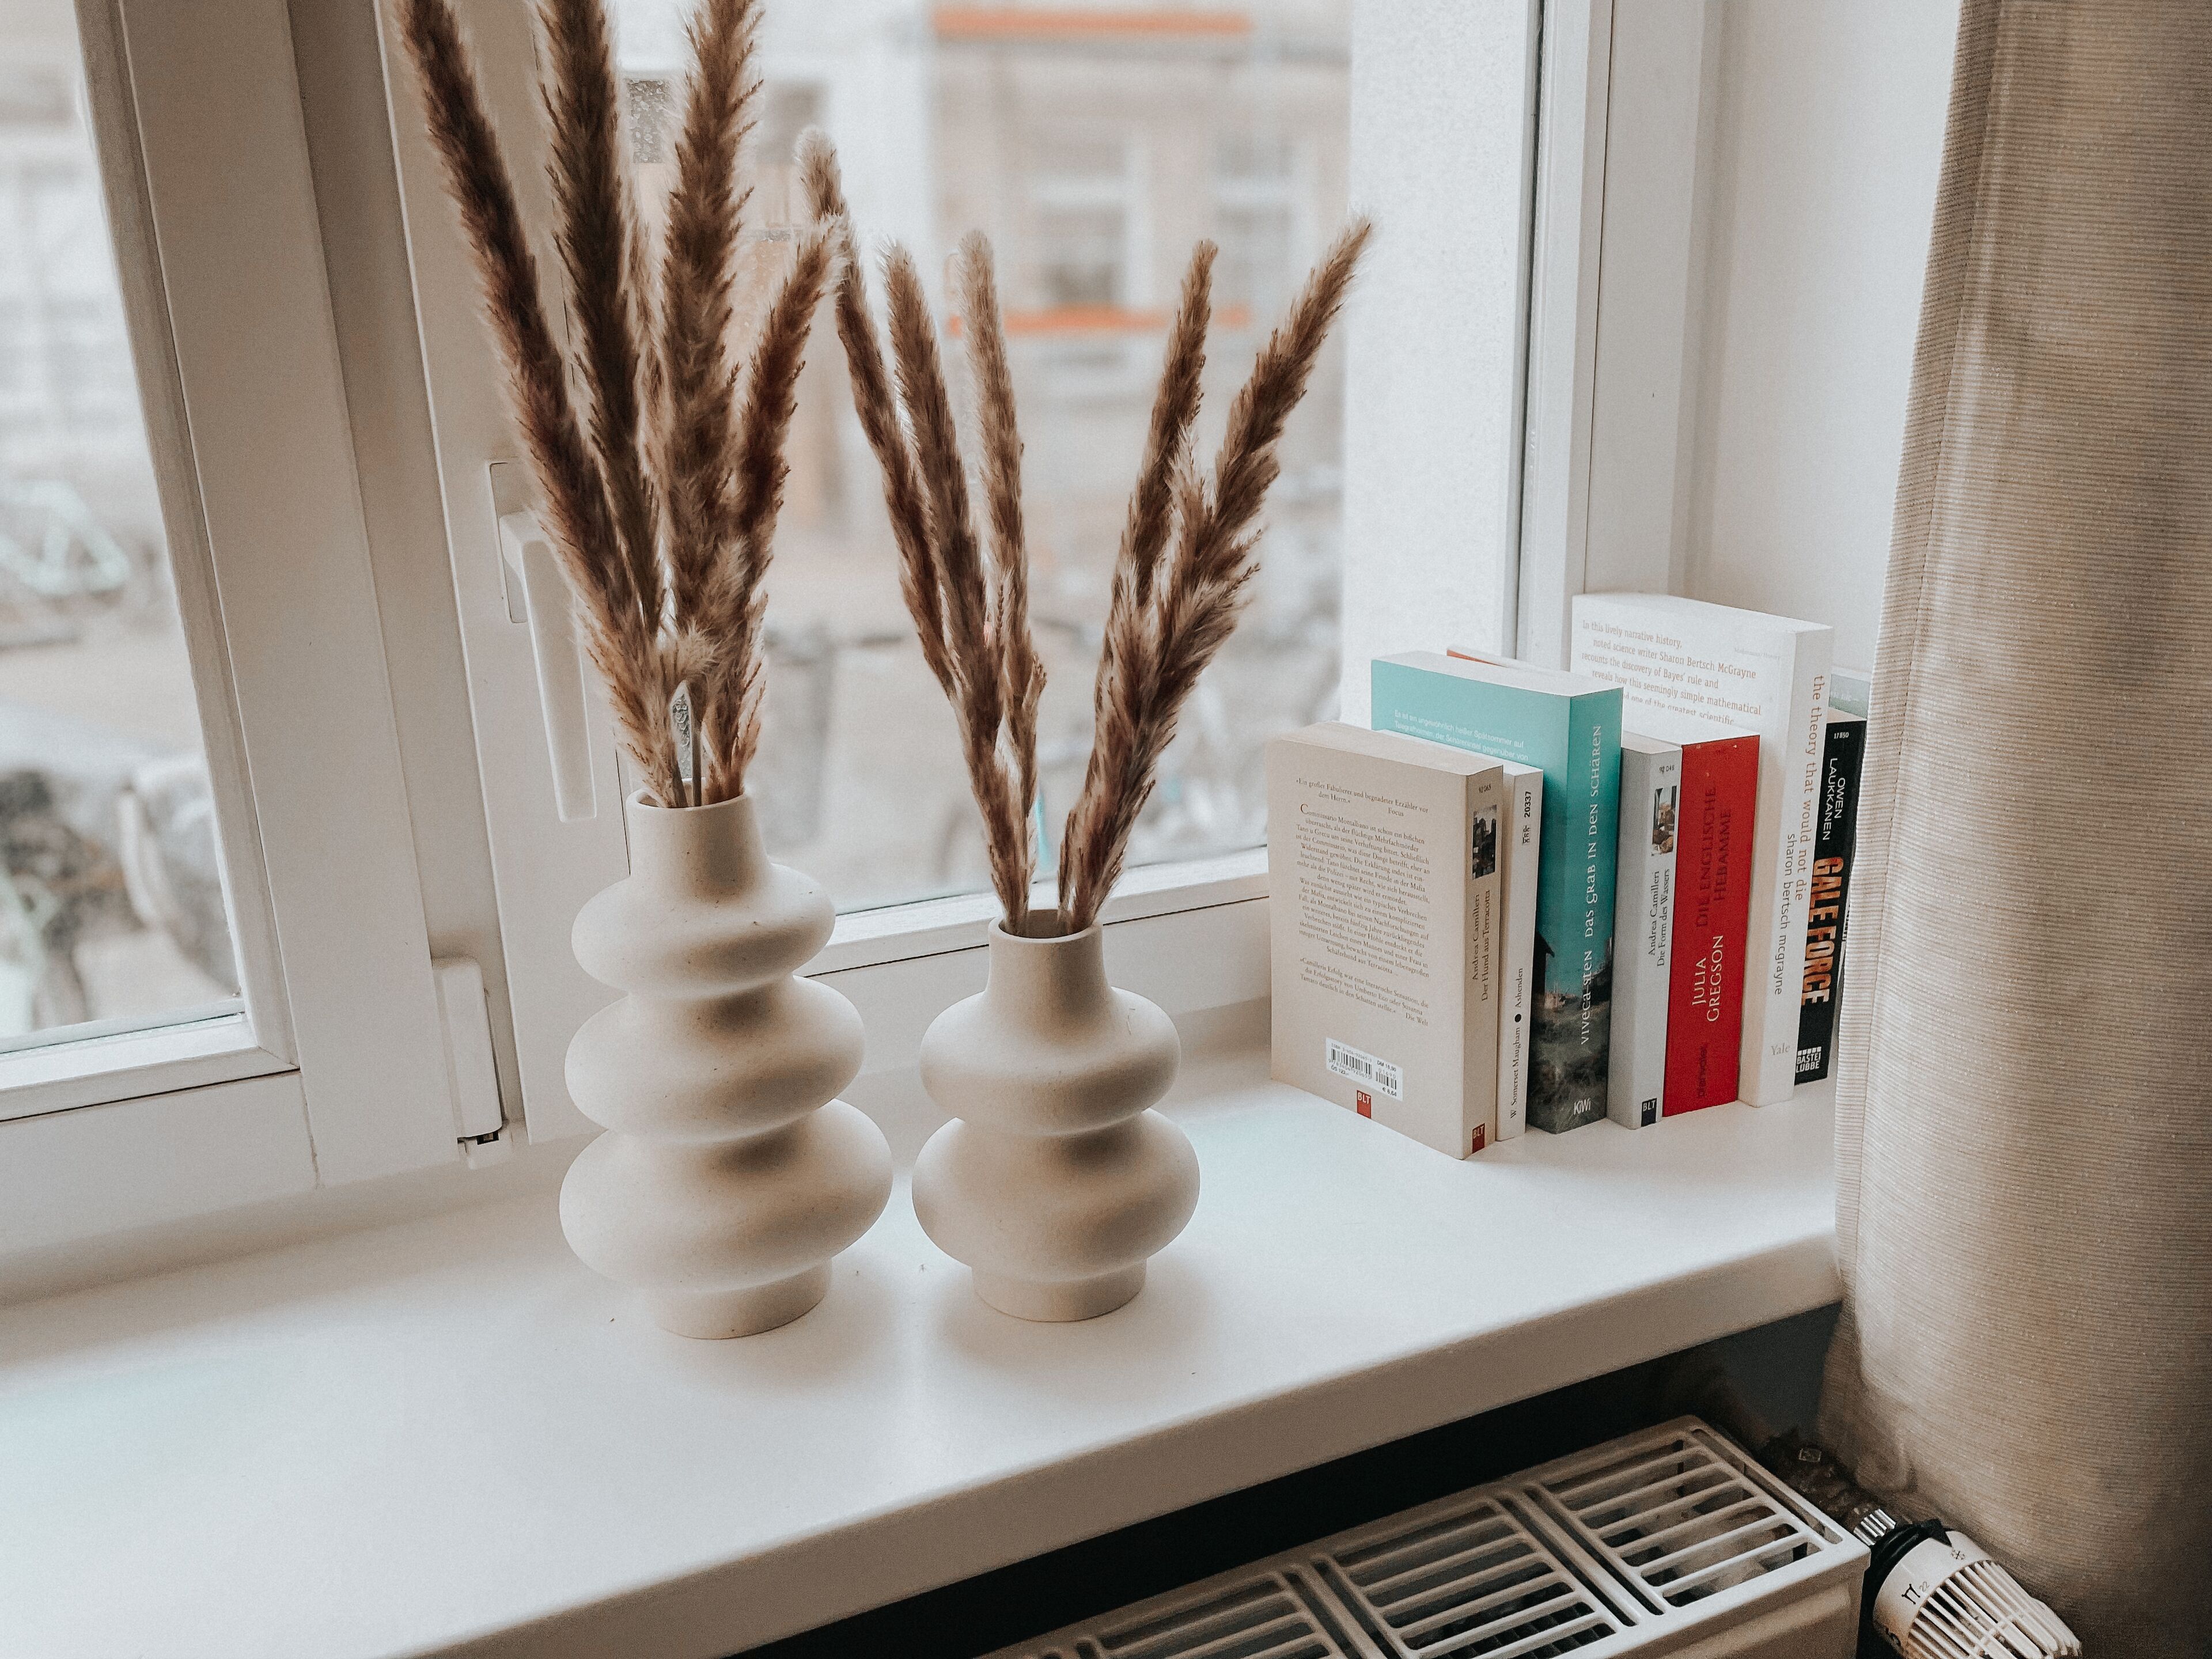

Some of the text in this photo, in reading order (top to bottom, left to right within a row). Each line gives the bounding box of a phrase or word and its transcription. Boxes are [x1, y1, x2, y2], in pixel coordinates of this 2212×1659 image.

[1582, 620, 1683, 648] In this lively narrative history,
[1582, 654, 1607, 665] recounts
[1609, 657, 1620, 667] the
[1622, 661, 1652, 675] discovery
[1654, 667, 1661, 676] of
[1687, 675, 1702, 685] rule
[1704, 678, 1718, 688] and
[1593, 639, 1756, 679] noted science writer Sharon Bertsch McGrayne
[1592, 671, 1613, 681] reveals
[1615, 675, 1628, 685] how
[1629, 677, 1642, 688] this
[1643, 682, 1678, 698] seemingly
[1680, 690, 1705, 706] simple
[1706, 696, 1762, 715] mathematical
[1474, 730, 1512, 745] Spätsommer
[1514, 740, 1524, 748] auf
[1365, 793, 1393, 804] begnadeter
[1395, 800, 1418, 810] Erzähler
[1795, 675, 1824, 901] the theory that would not die
[1823, 758, 1838, 840] LAUKKANEN
[1834, 778, 1845, 819] OWEN
[1338, 816, 1369, 830] Montalbano
[1388, 807, 1404, 816] Focus
[1397, 906, 1427, 921] Verbrechen
[1648, 870, 1660, 956] Andrea Camilleri
[1657, 869, 1669, 967] Die Form des Wassers
[1774, 834, 1796, 995] sharon bertsch mcgrayne
[1801, 857, 1844, 1006] GALE FORCE
[1515, 968, 1523, 1008] Ashenden
[1692, 957, 1706, 1005] JULIA
[1707, 935, 1724, 1022] GREGSON
[1513, 1028, 1521, 1066] Maugham
[1771, 1044, 1790, 1056] Yale
[1797, 1052, 1821, 1065] BASTEI
[1358, 1092, 1370, 1104] BLT
[1643, 1100, 1656, 1112] BLT
[1473, 1126, 1484, 1139] BLT
